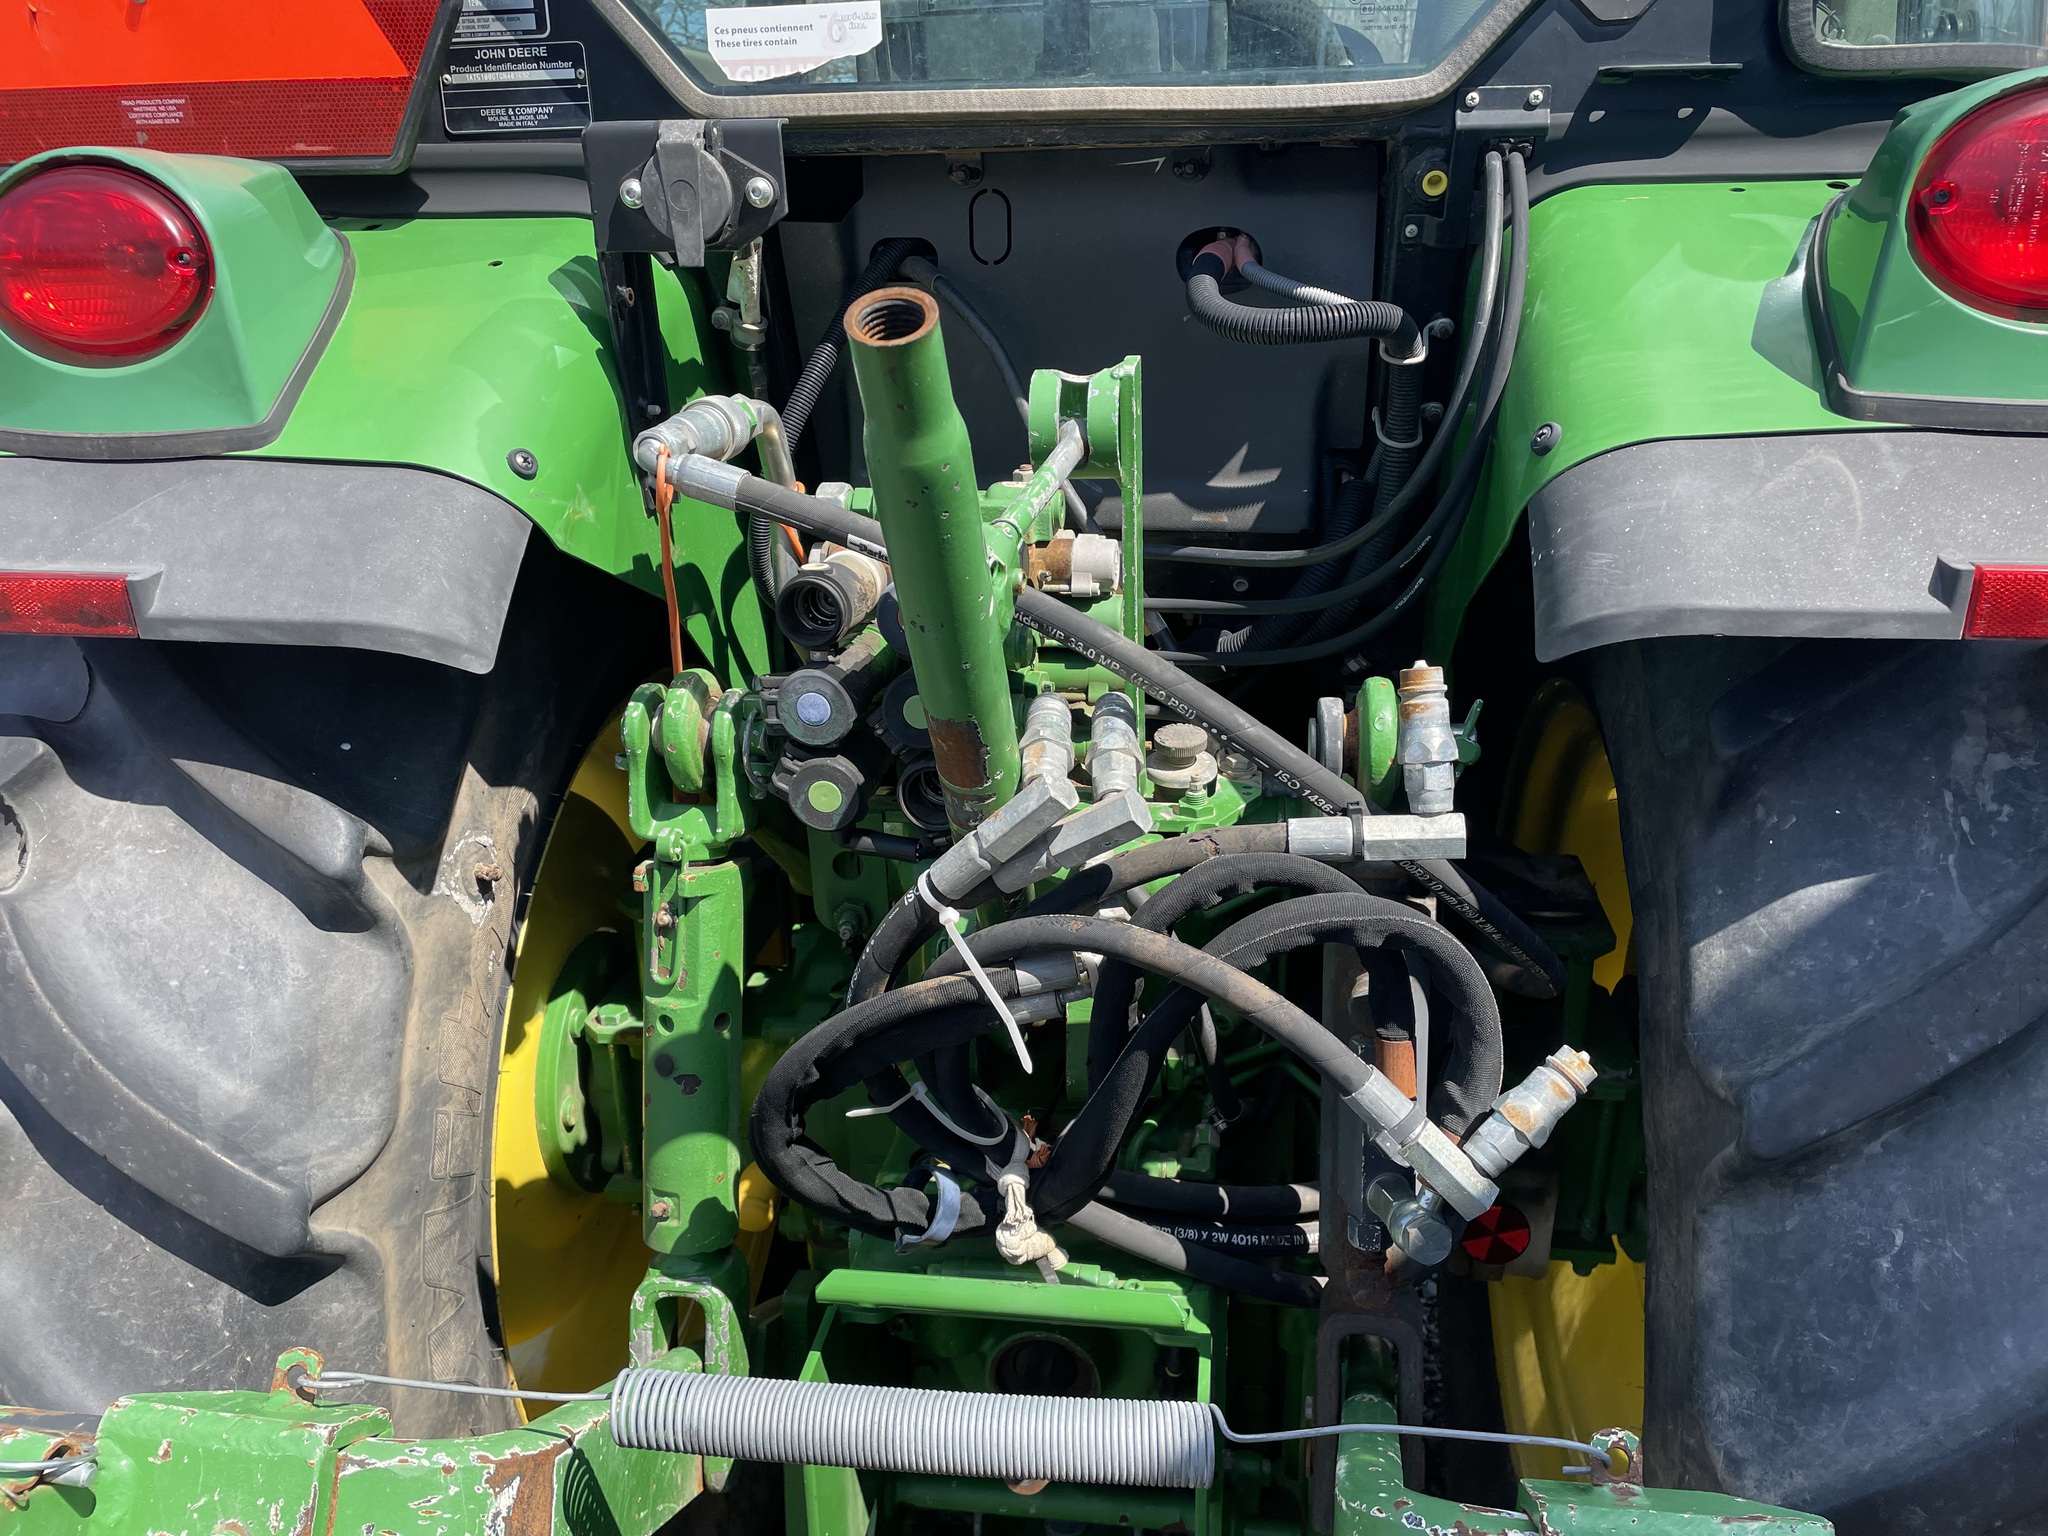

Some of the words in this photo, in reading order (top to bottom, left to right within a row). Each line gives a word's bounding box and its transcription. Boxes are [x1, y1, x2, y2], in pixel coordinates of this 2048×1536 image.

[714, 26, 730, 35] Ces
[731, 26, 758, 37] pneus
[759, 23, 814, 34] contiennent
[715, 39, 741, 48] These
[742, 38, 763, 47] tires
[764, 36, 798, 46] contain
[474, 48, 506, 60] JOHN
[508, 46, 548, 58] DEERE
[450, 63, 483, 74] Product
[484, 61, 538, 72] Identification
[539, 60, 573, 70] Number
[480, 108, 507, 117] DEERE
[507, 107, 514, 115] &
[515, 106, 554, 115] COMPANY
[1067, 637, 1096, 659] 33.0
[1167, 696, 1197, 720] PSI)
[1273, 769, 1301, 791] ISO
[1428, 876, 1444, 894] 10
[1174, 1225, 1198, 1242] (3/8)
[1200, 1230, 1209, 1241] X
[1211, 1231, 1229, 1244] 2W
[1231, 1234, 1258, 1246] 4Q16
[1293, 1234, 1304, 1246] IN
